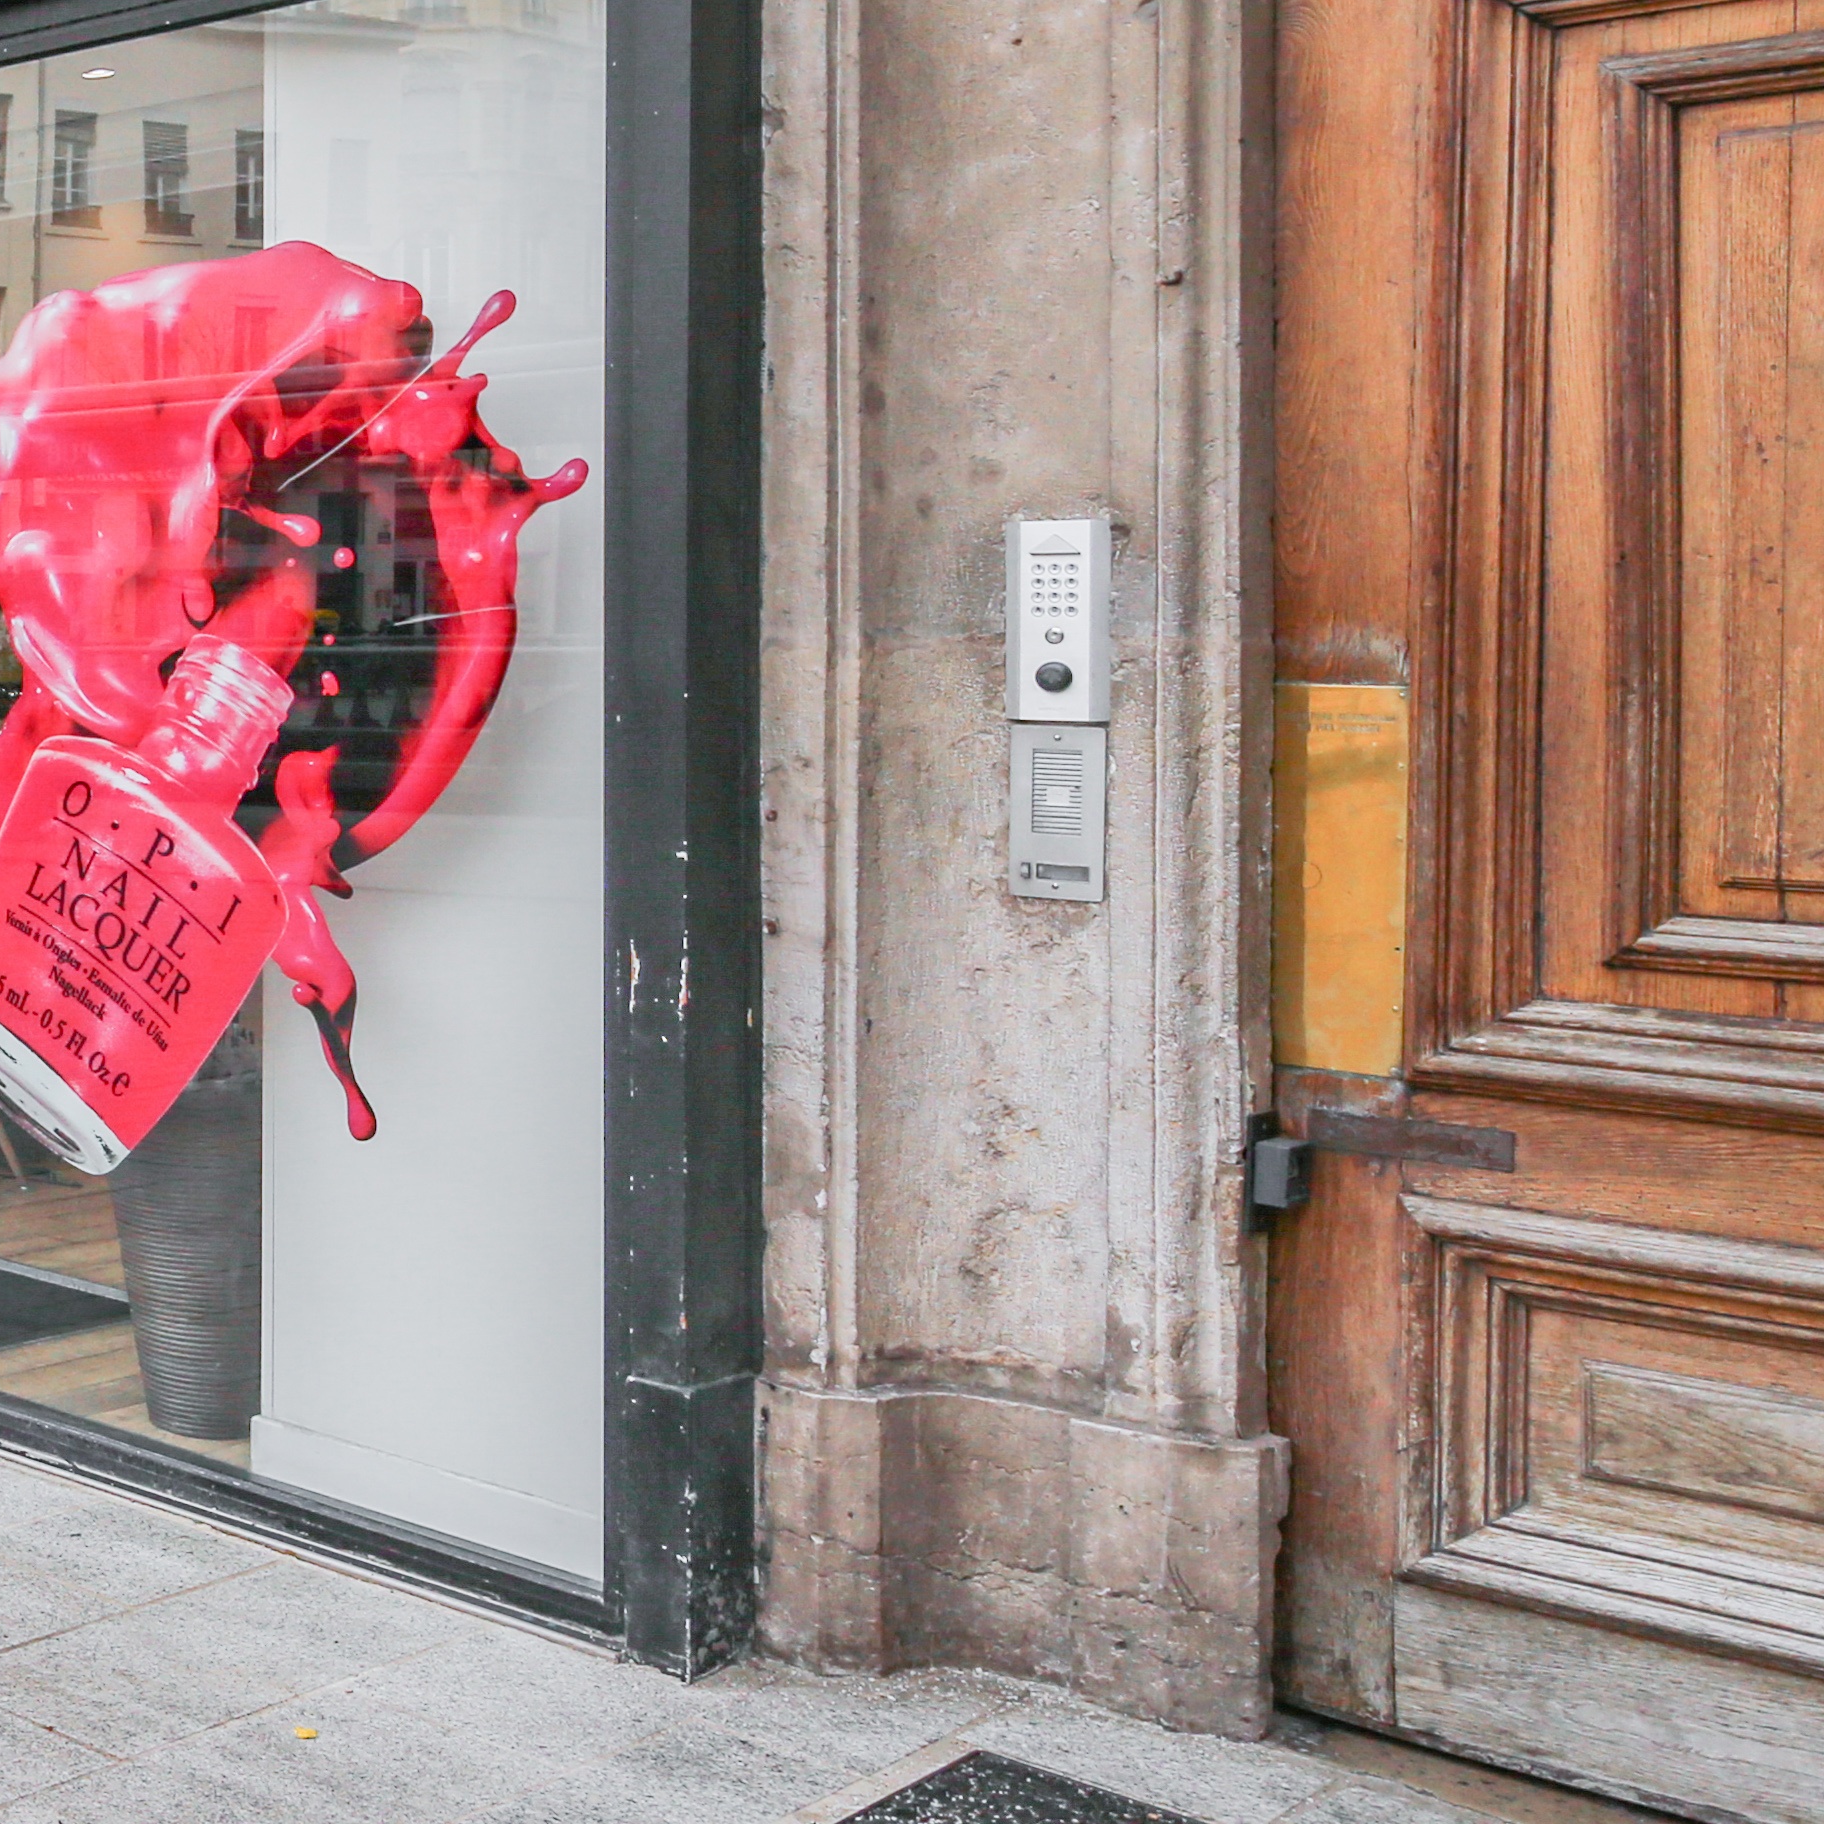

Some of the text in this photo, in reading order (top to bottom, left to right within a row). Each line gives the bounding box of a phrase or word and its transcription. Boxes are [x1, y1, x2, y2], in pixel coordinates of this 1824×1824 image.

[24, 862, 191, 1015] LACQUER
[60, 836, 190, 961] NAIL
[5, 909, 169, 1053] Vernis à Ongles Esmalte de Uñas
[5, 987, 31, 1015] mL
[40, 1008, 68, 1040] 0.5
[65, 1029, 88, 1061] Fl.
[48, 964, 108, 1022] Nagellack
